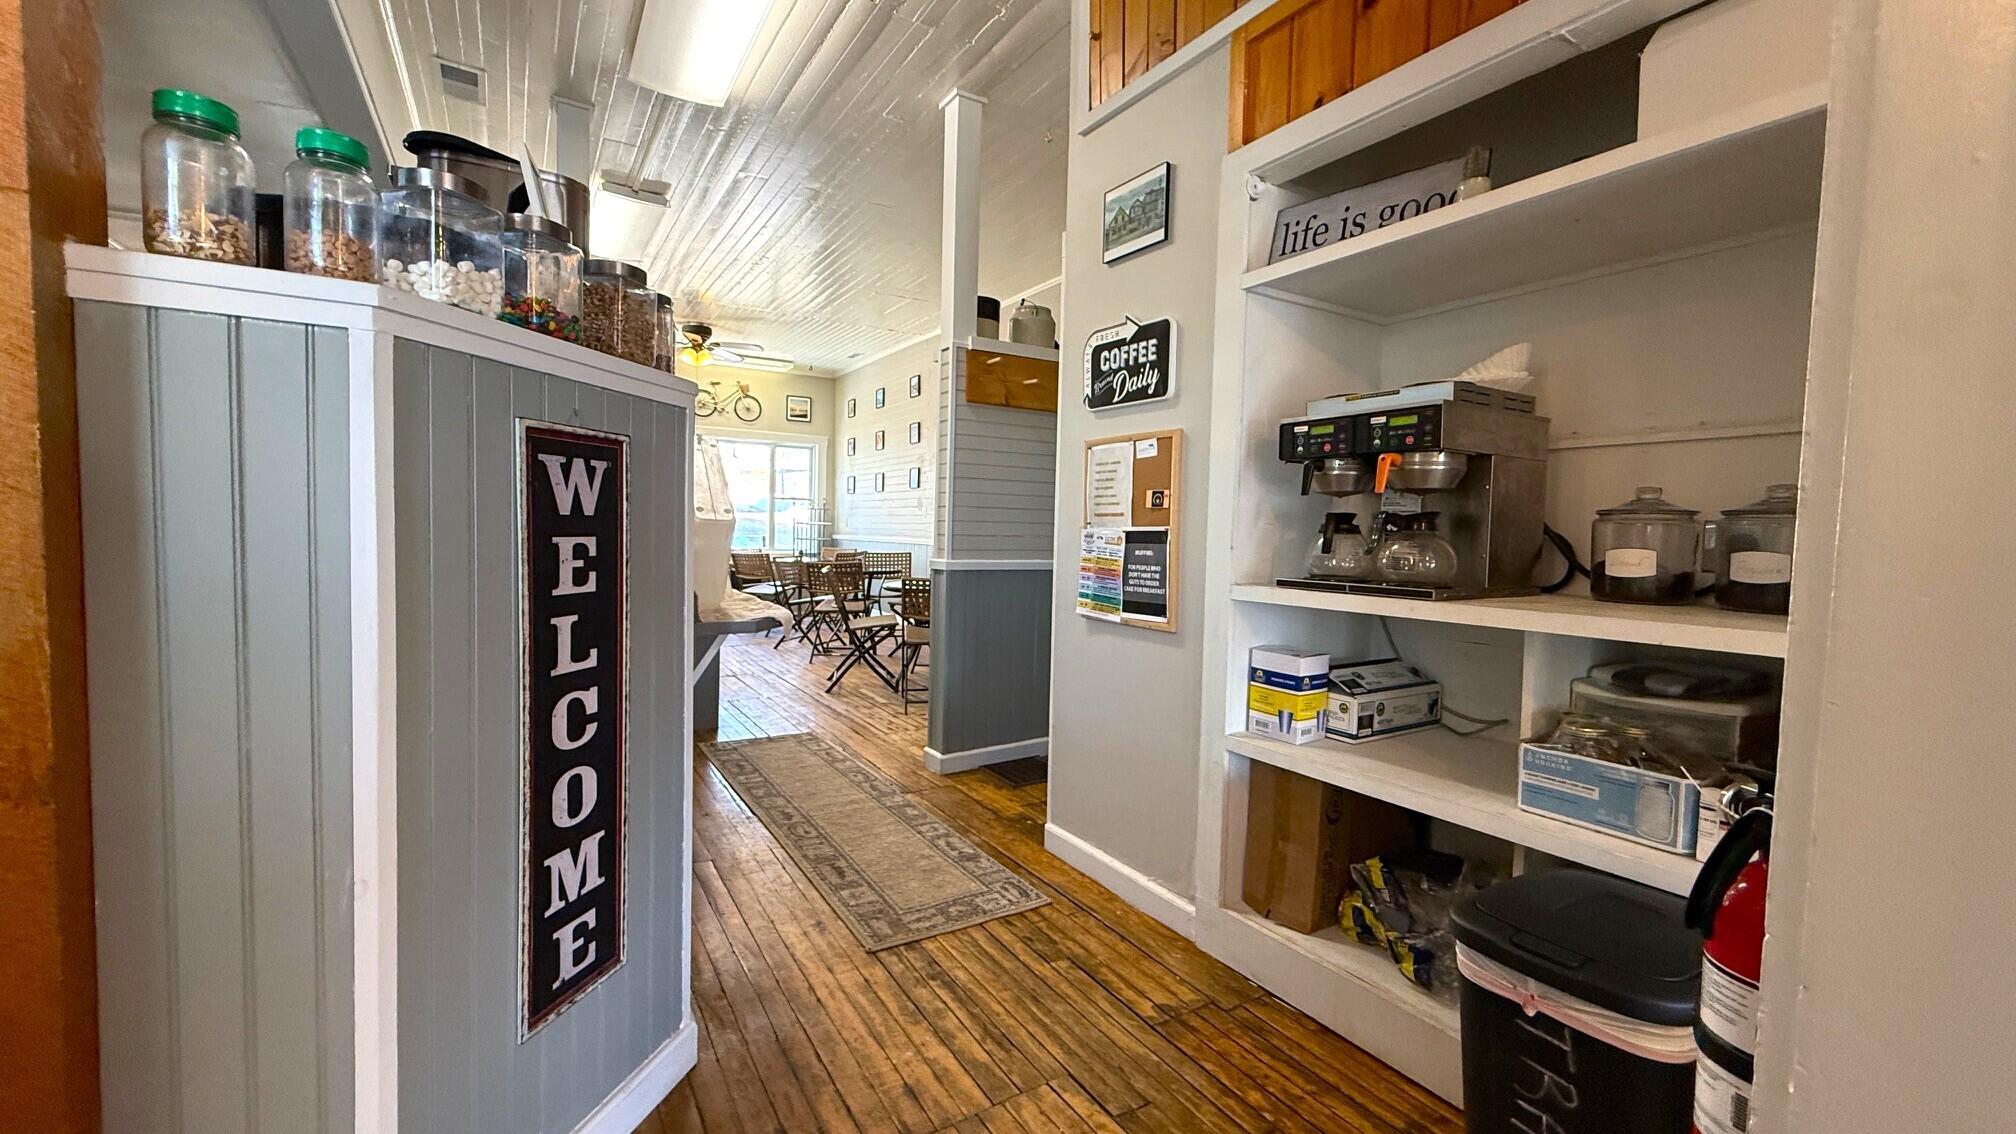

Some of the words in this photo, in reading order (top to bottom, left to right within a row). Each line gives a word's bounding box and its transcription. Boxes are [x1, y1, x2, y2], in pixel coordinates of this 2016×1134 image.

[1278, 214, 1329, 257] life
[1338, 205, 1367, 241] is
[1378, 189, 1458, 229] goo
[1085, 342, 1093, 389] ALWAYS
[1095, 330, 1120, 342] FRESH
[1100, 338, 1159, 372] COFFEE
[1112, 362, 1160, 403] Daily
[537, 452, 610, 991] WELCOME
